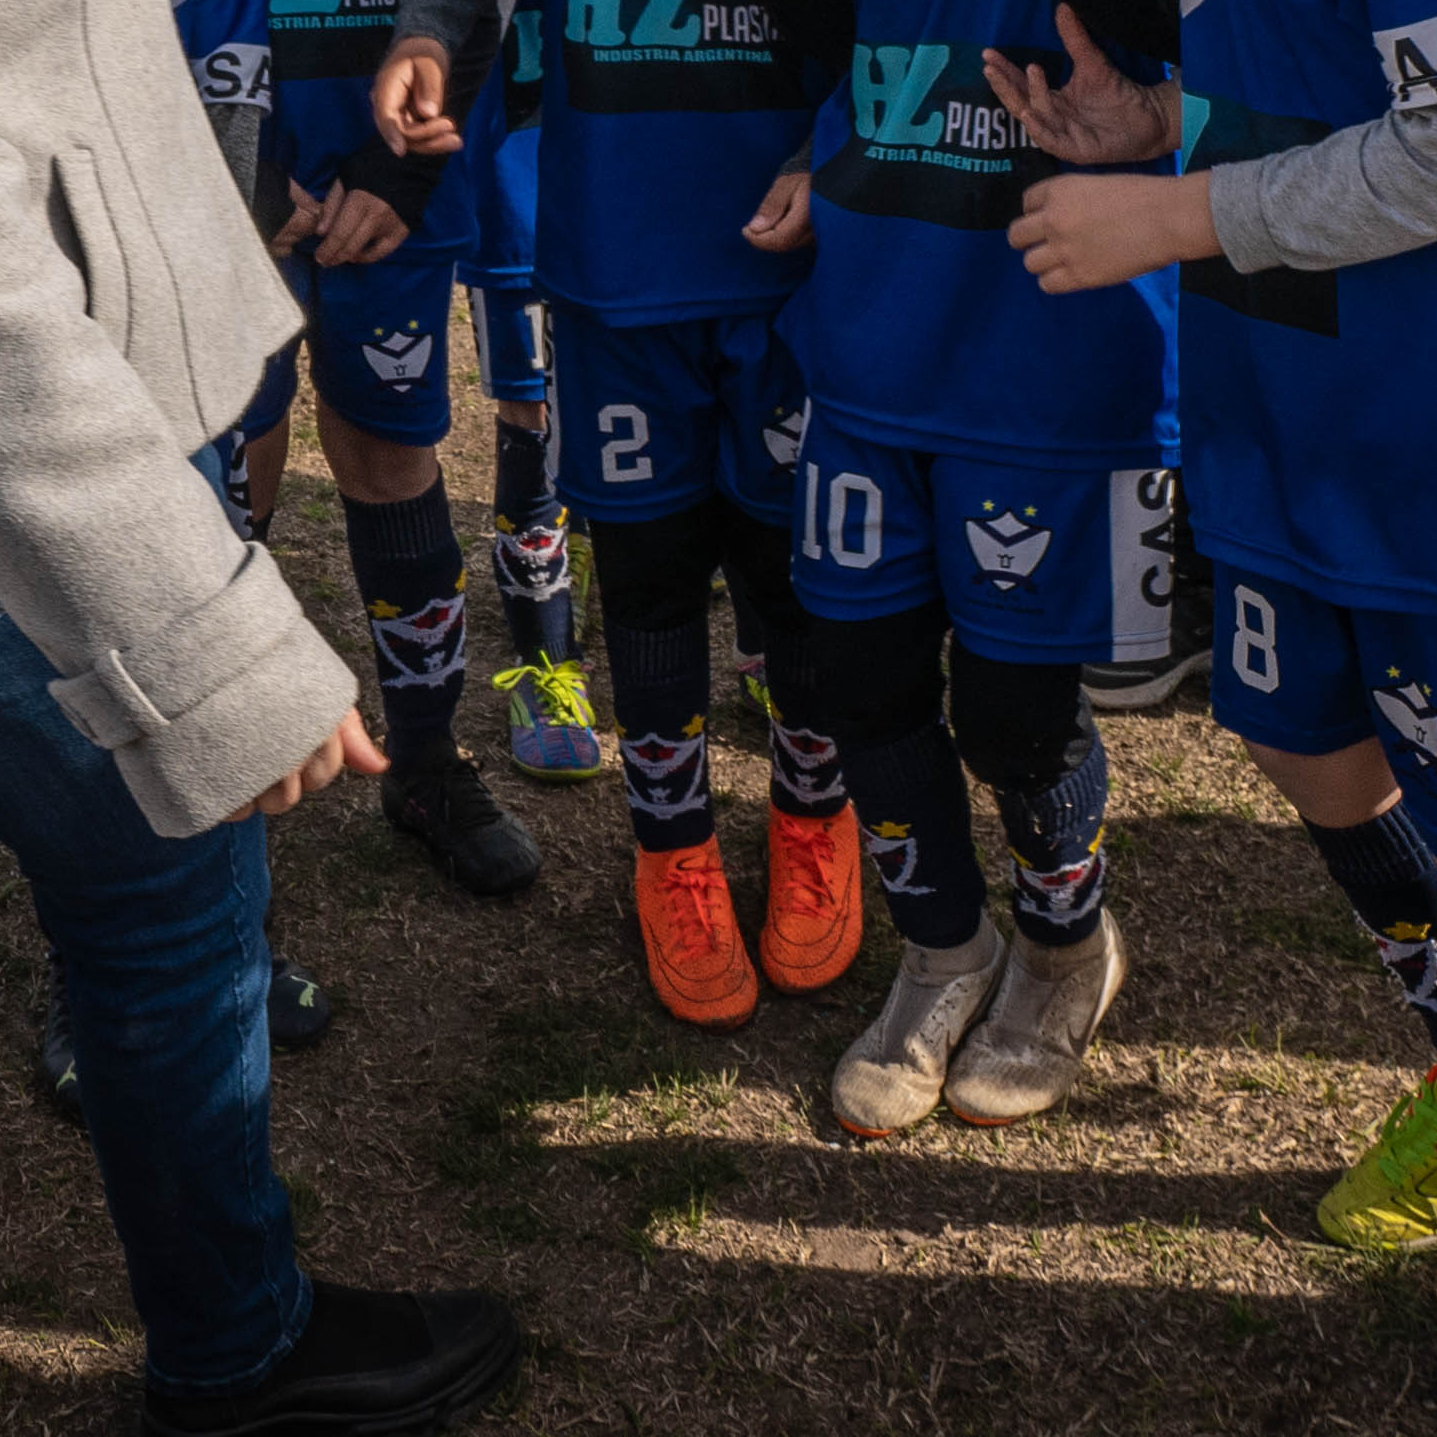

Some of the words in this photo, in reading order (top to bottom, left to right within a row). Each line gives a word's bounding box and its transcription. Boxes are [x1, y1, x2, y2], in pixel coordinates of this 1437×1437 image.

[594, 48, 680, 63] INDUSTRIA
[683, 49, 773, 64] ARGENTINA
[852, 43, 950, 147] HZ
[921, 149, 1013, 174] ARGENTINA
[598, 404, 653, 482] 2
[802, 461, 883, 569] 10
[1233, 585, 1280, 693] 8
